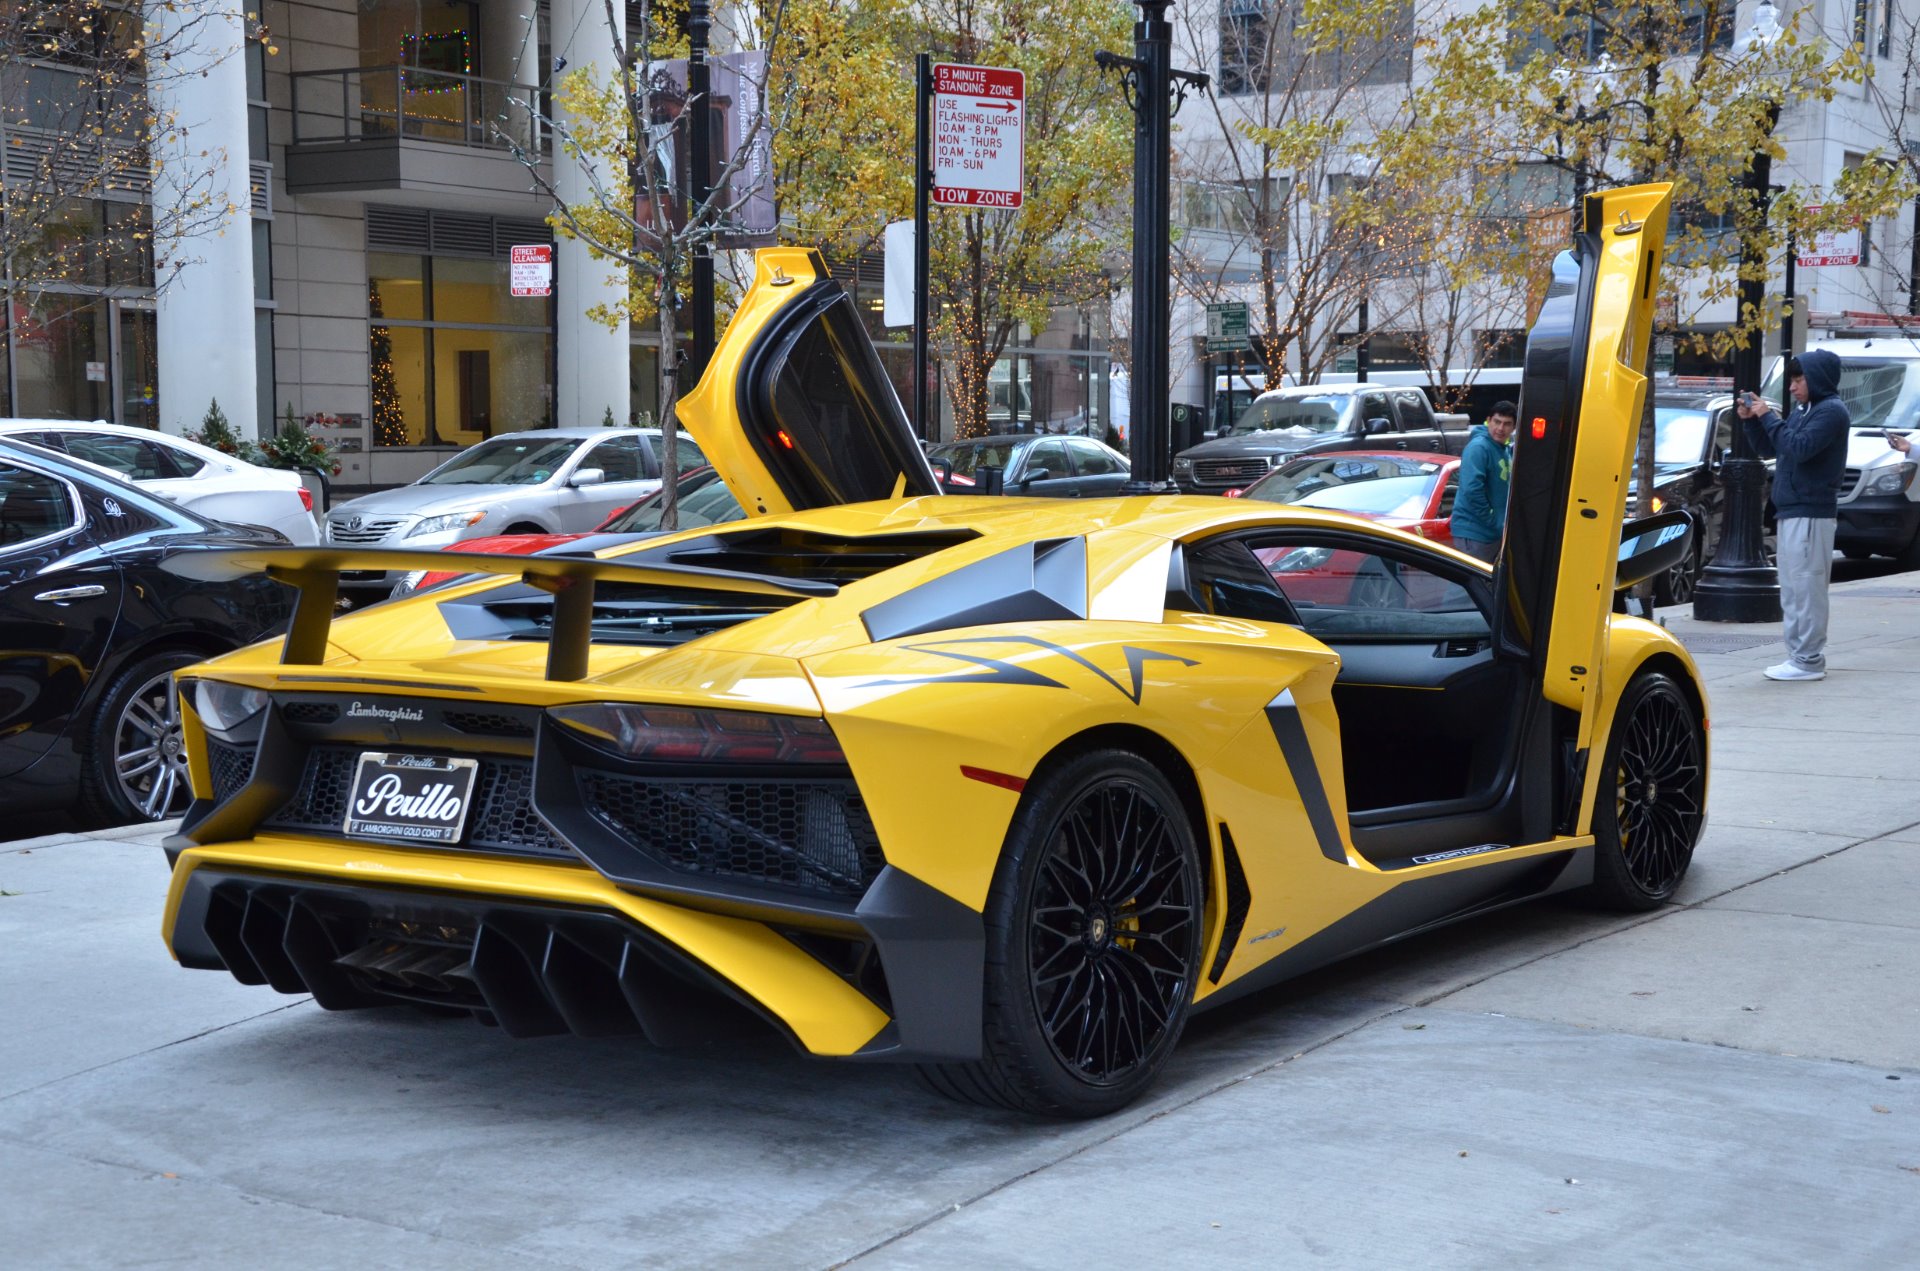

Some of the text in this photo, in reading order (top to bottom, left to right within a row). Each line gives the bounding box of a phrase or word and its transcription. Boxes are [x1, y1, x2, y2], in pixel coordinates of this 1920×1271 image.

[940, 68, 986, 82] 15 MINUTE
[748, 62, 758, 112] Macella
[940, 80, 1014, 96] STANDING ZONE
[940, 99, 958, 110] USE
[938, 110, 1018, 127] FLASHING LIGHTS
[940, 123, 948, 132] 10
[951, 124, 965, 134] AM
[975, 126, 981, 134] 8
[984, 126, 998, 136] PM
[938, 134, 960, 145] MON
[970, 136, 1002, 148] THURS
[940, 146, 948, 156] 10
[950, 147, 964, 157] AM
[974, 149, 980, 158] 6
[983, 150, 996, 160] PM
[938, 158, 954, 168] FRI
[963, 160, 984, 170] SUN
[938, 188, 1014, 206] TOW ZONE
[514, 248, 537, 256] STREET
[1802, 256, 1854, 266] TOW ZONE
[346, 701, 424, 721] Lamborghini
[398, 754, 436, 767] Perillo
[356, 774, 461, 821] Perillo
[360, 824, 442, 838] LAMBORGHINI GOLD COAST
